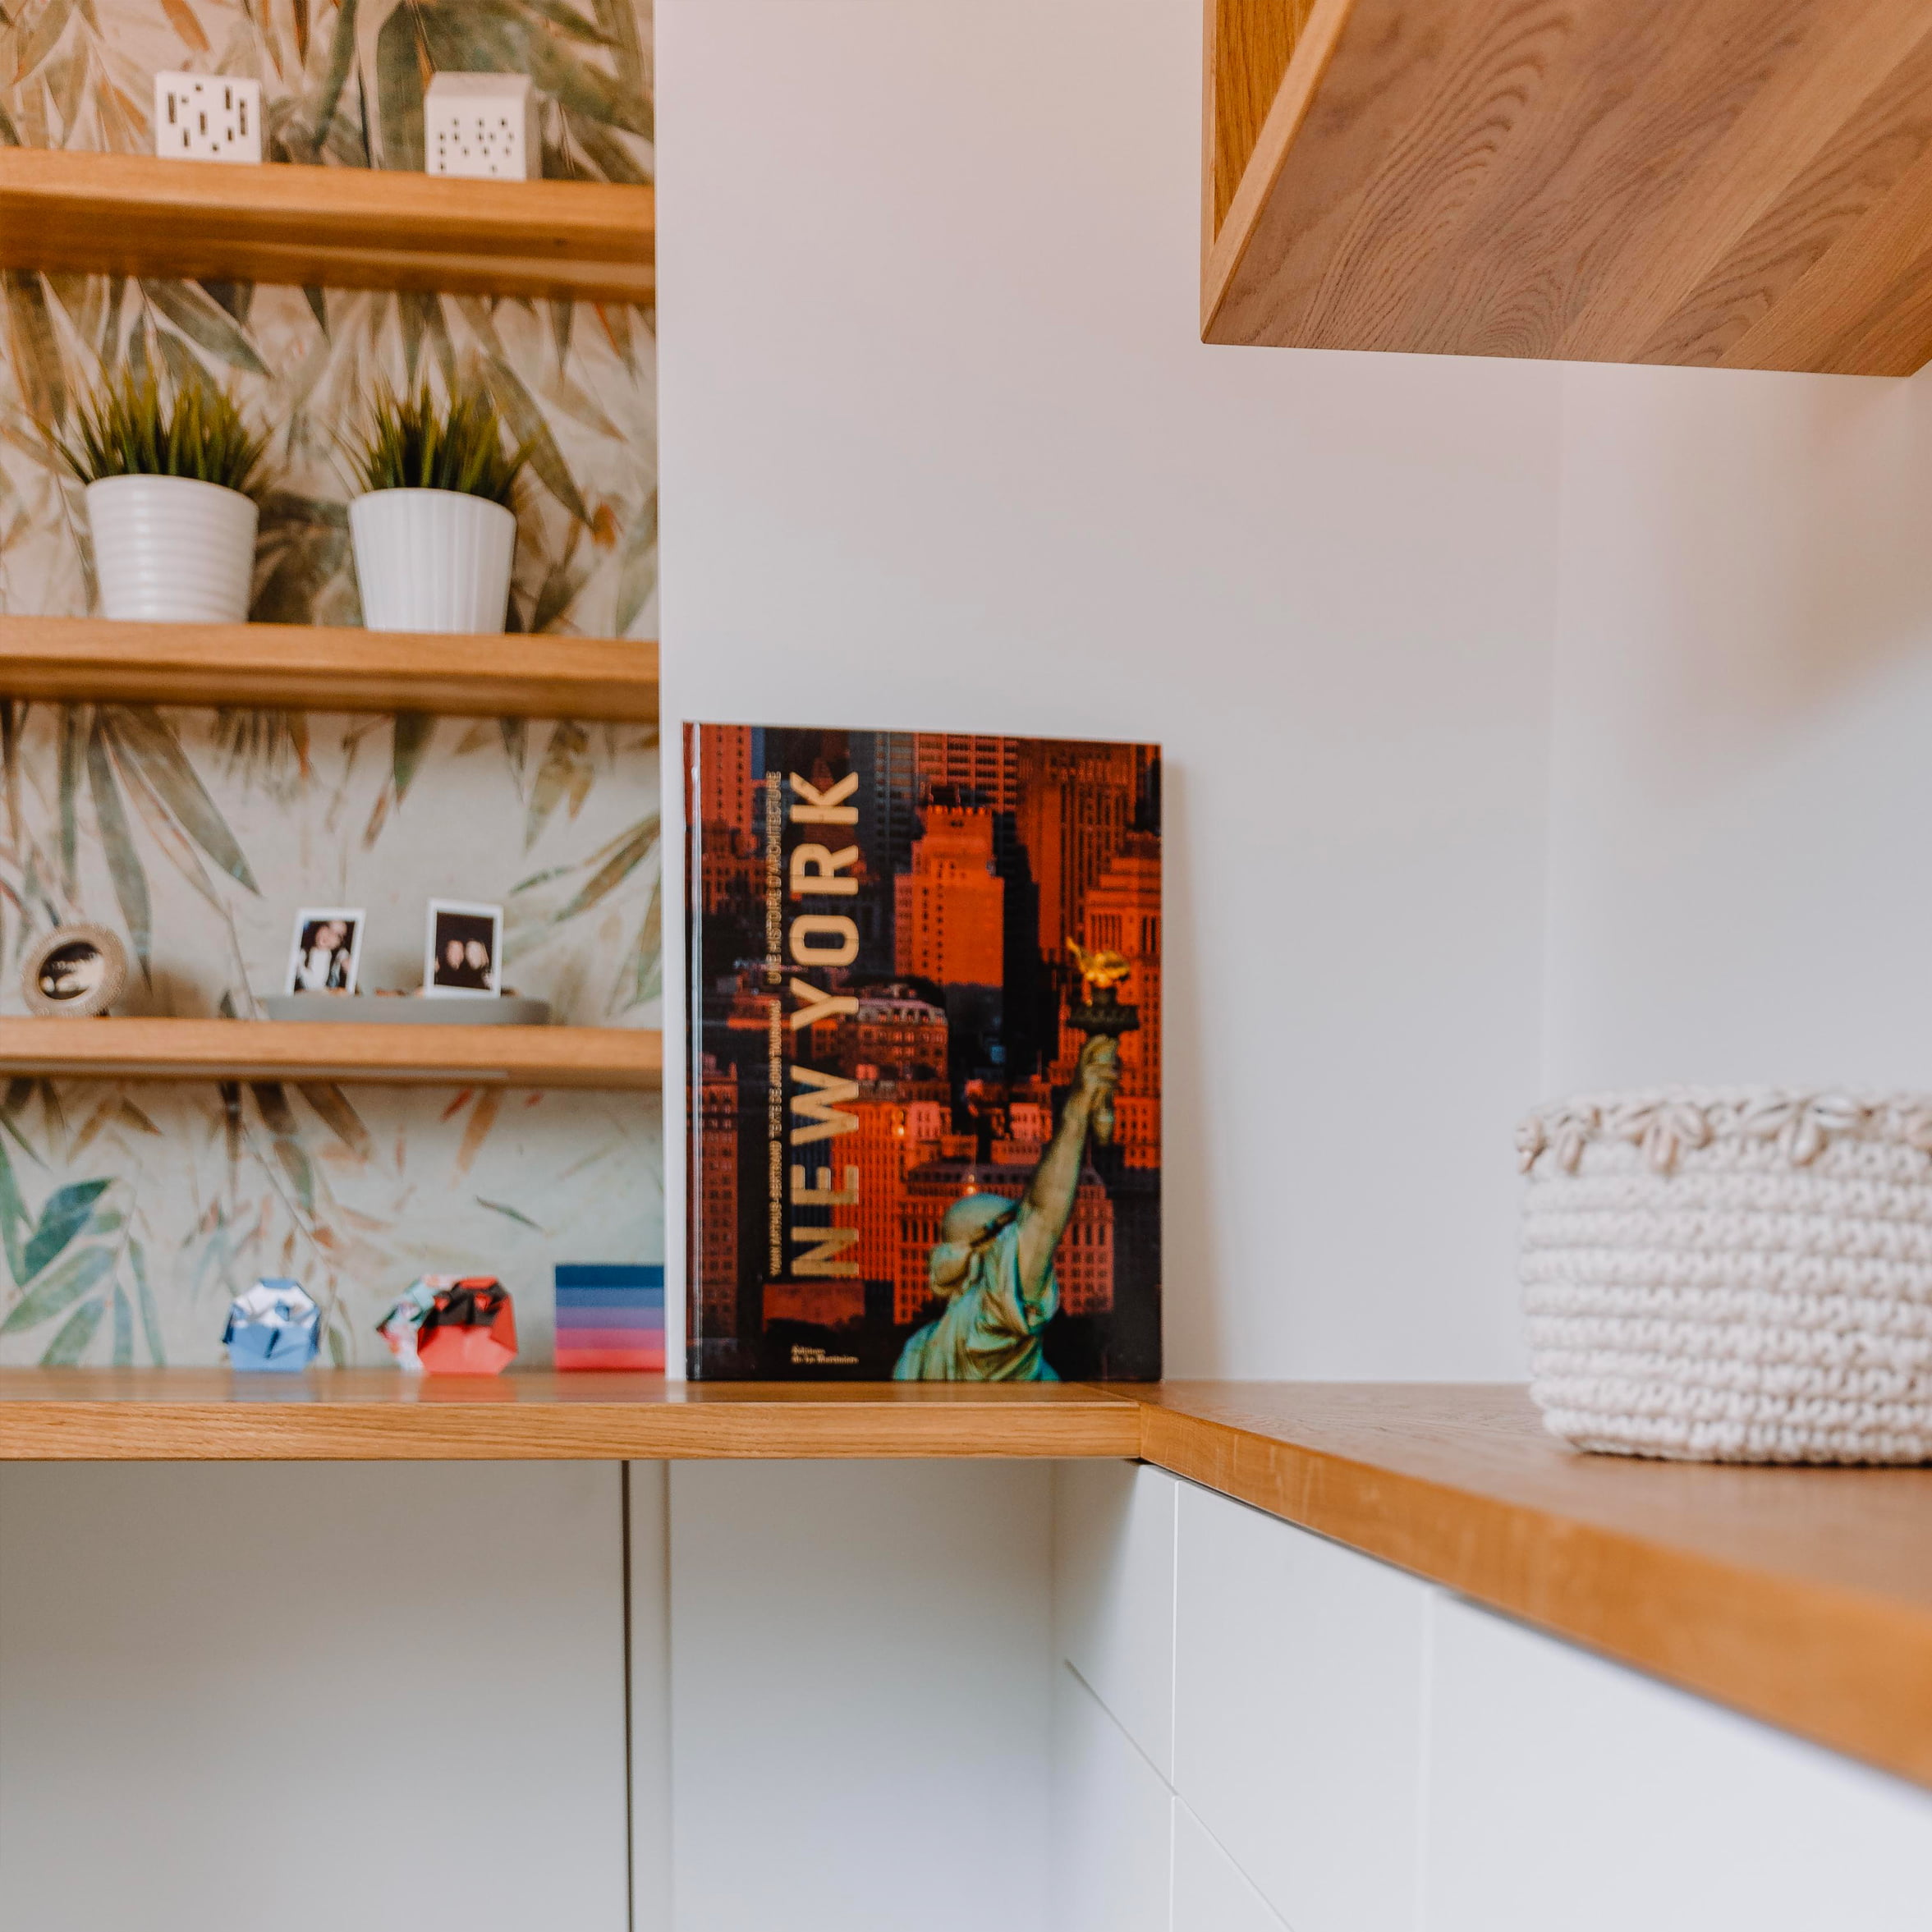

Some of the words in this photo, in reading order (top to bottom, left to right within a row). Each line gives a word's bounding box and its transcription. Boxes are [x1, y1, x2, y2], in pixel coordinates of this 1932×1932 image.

[766, 889, 782, 953] HISTOIRE
[789, 772, 860, 1030] YORK
[790, 1065, 859, 1276] NEW
